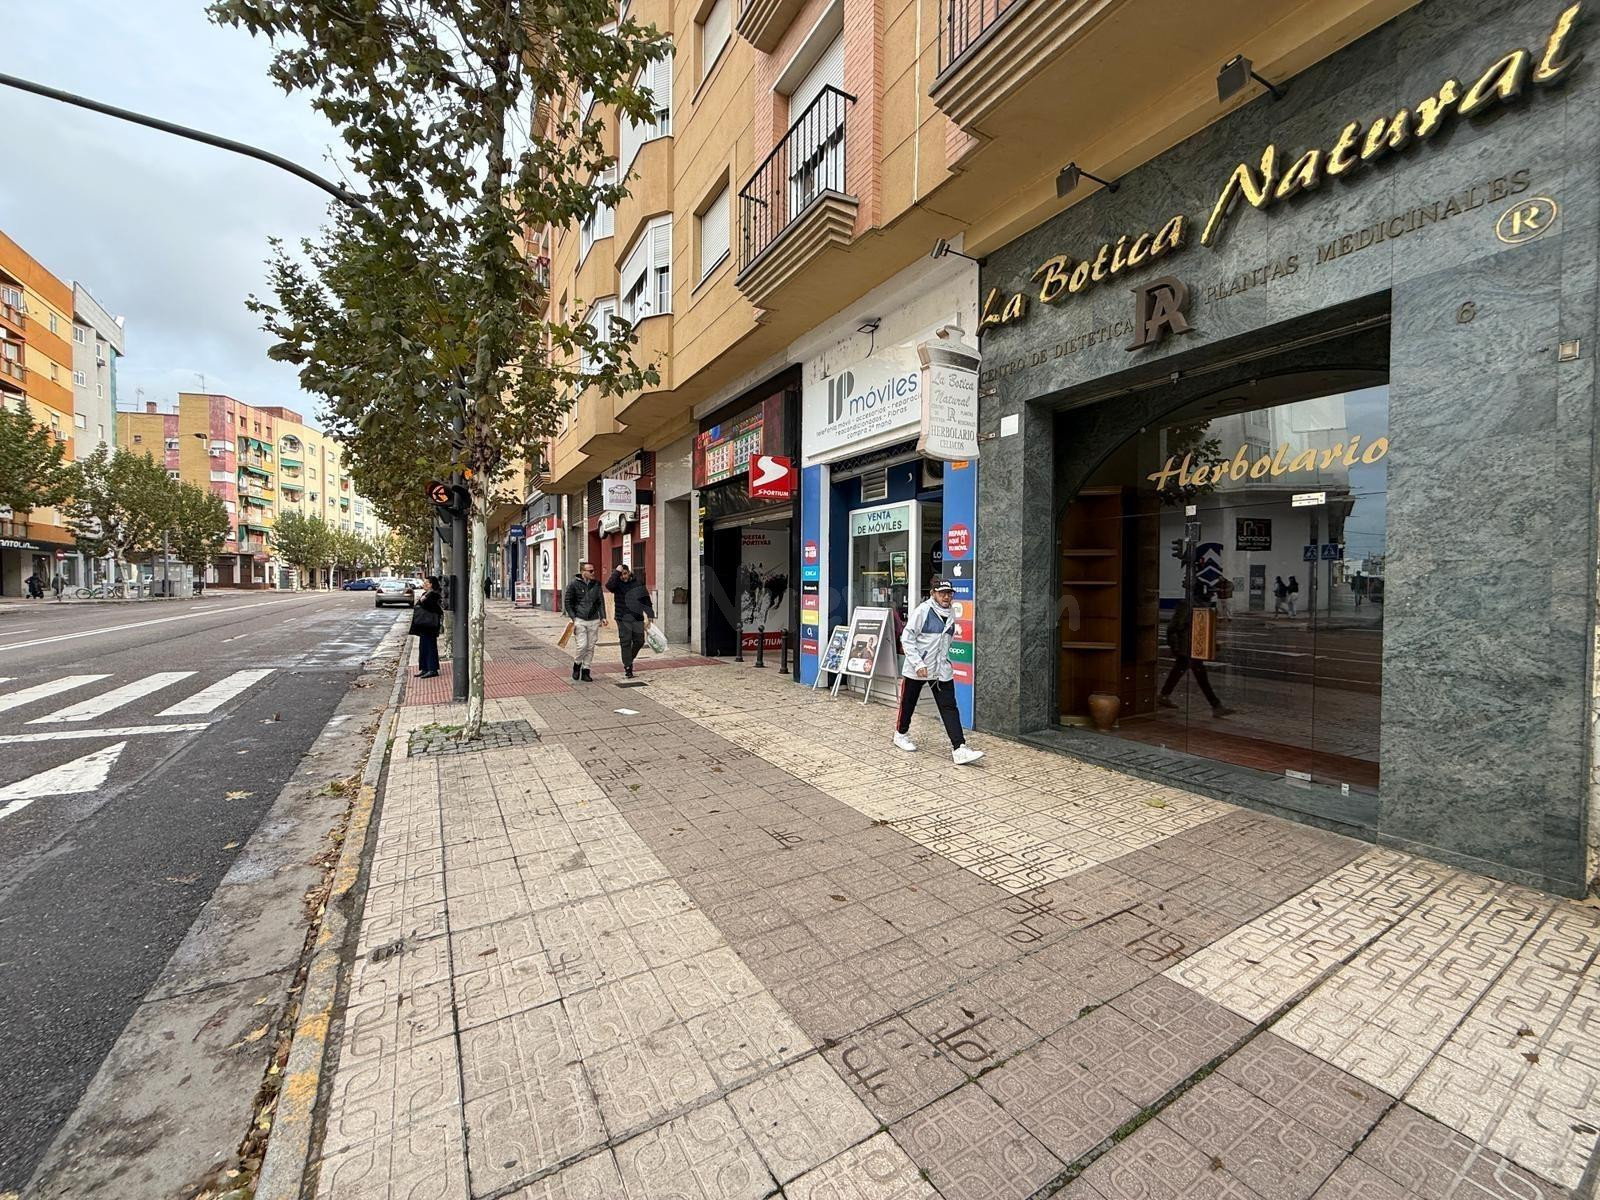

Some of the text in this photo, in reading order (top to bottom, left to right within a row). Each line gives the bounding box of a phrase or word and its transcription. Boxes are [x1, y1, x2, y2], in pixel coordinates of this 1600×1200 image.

[977, 2, 1582, 336] La Botica Natural
[1205, 168, 1531, 304] PLANTAS MEDICINALES
[1456, 301, 1477, 324] 6
[980, 318, 1133, 384] CENTRO DE DIETETICA
[948, 373, 974, 391] Botica
[850, 373, 917, 416] móviles
[856, 408, 886, 422] accesorios
[847, 428, 868, 440] compra
[875, 419, 892, 430] mano
[931, 425, 975, 441] HERBOLARIO
[1147, 435, 1389, 491] Herbolario
[867, 511, 892, 521] VENTA
[857, 520, 902, 534] DE MÓVILES
[742, 638, 783, 648] SPOTIUM
[949, 647, 965, 655] oppo
